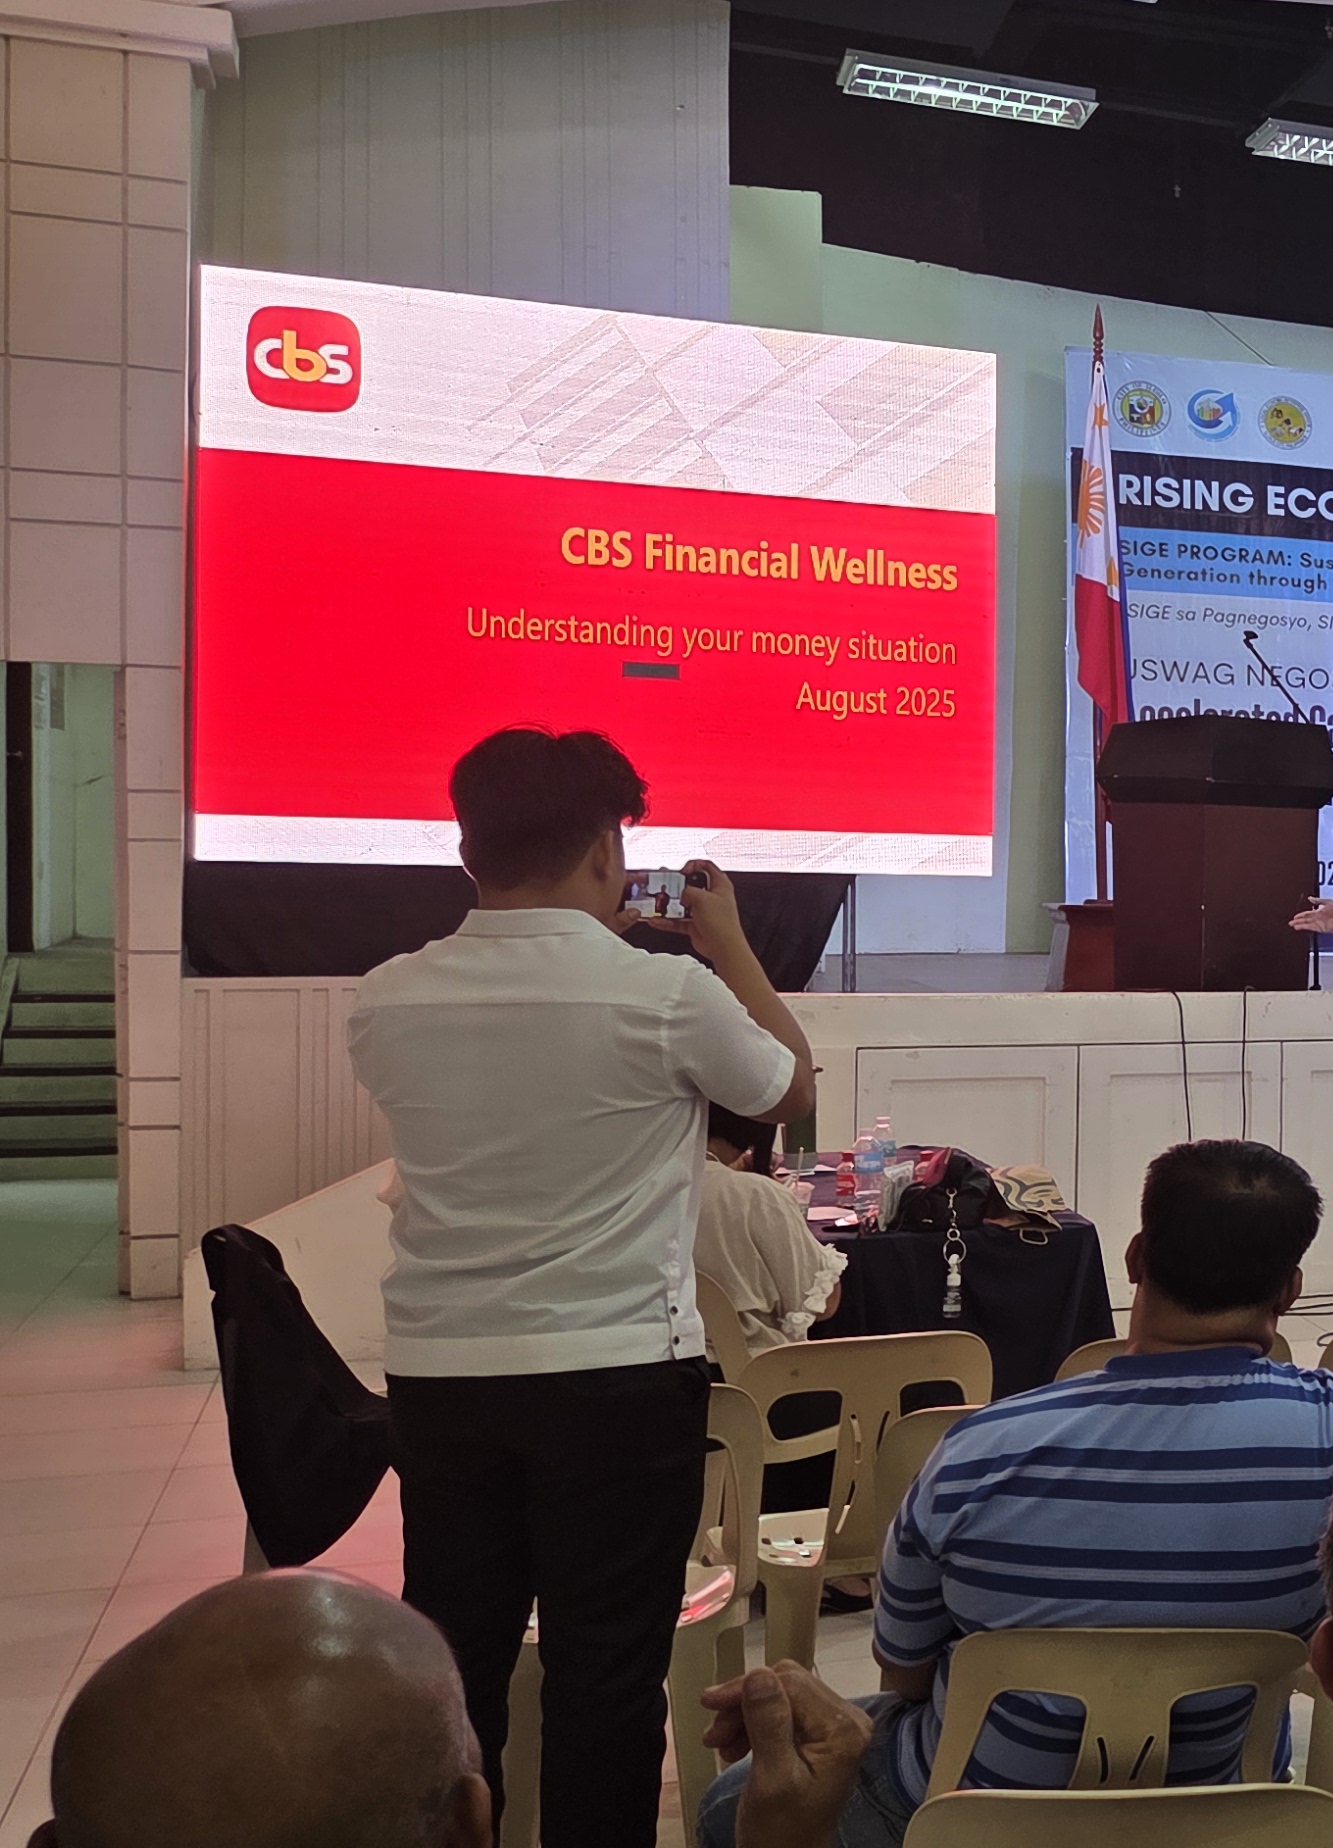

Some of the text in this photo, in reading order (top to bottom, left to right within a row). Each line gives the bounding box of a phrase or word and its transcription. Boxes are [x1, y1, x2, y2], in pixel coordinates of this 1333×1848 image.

[254, 329, 353, 385] cbs
[1119, 473, 1254, 514] RISING
[560, 526, 958, 591] CBS Financial Wellness
[1119, 539, 1170, 558] SIGE
[1177, 543, 1292, 567] PROGRAM:
[1121, 561, 1241, 584] Generation
[1248, 568, 1328, 595] through
[466, 606, 957, 666] Understanding your money situation
[1176, 609, 1197, 622] sa
[1202, 607, 1312, 632] Pagnegosyo,
[795, 682, 956, 722] August 2025
